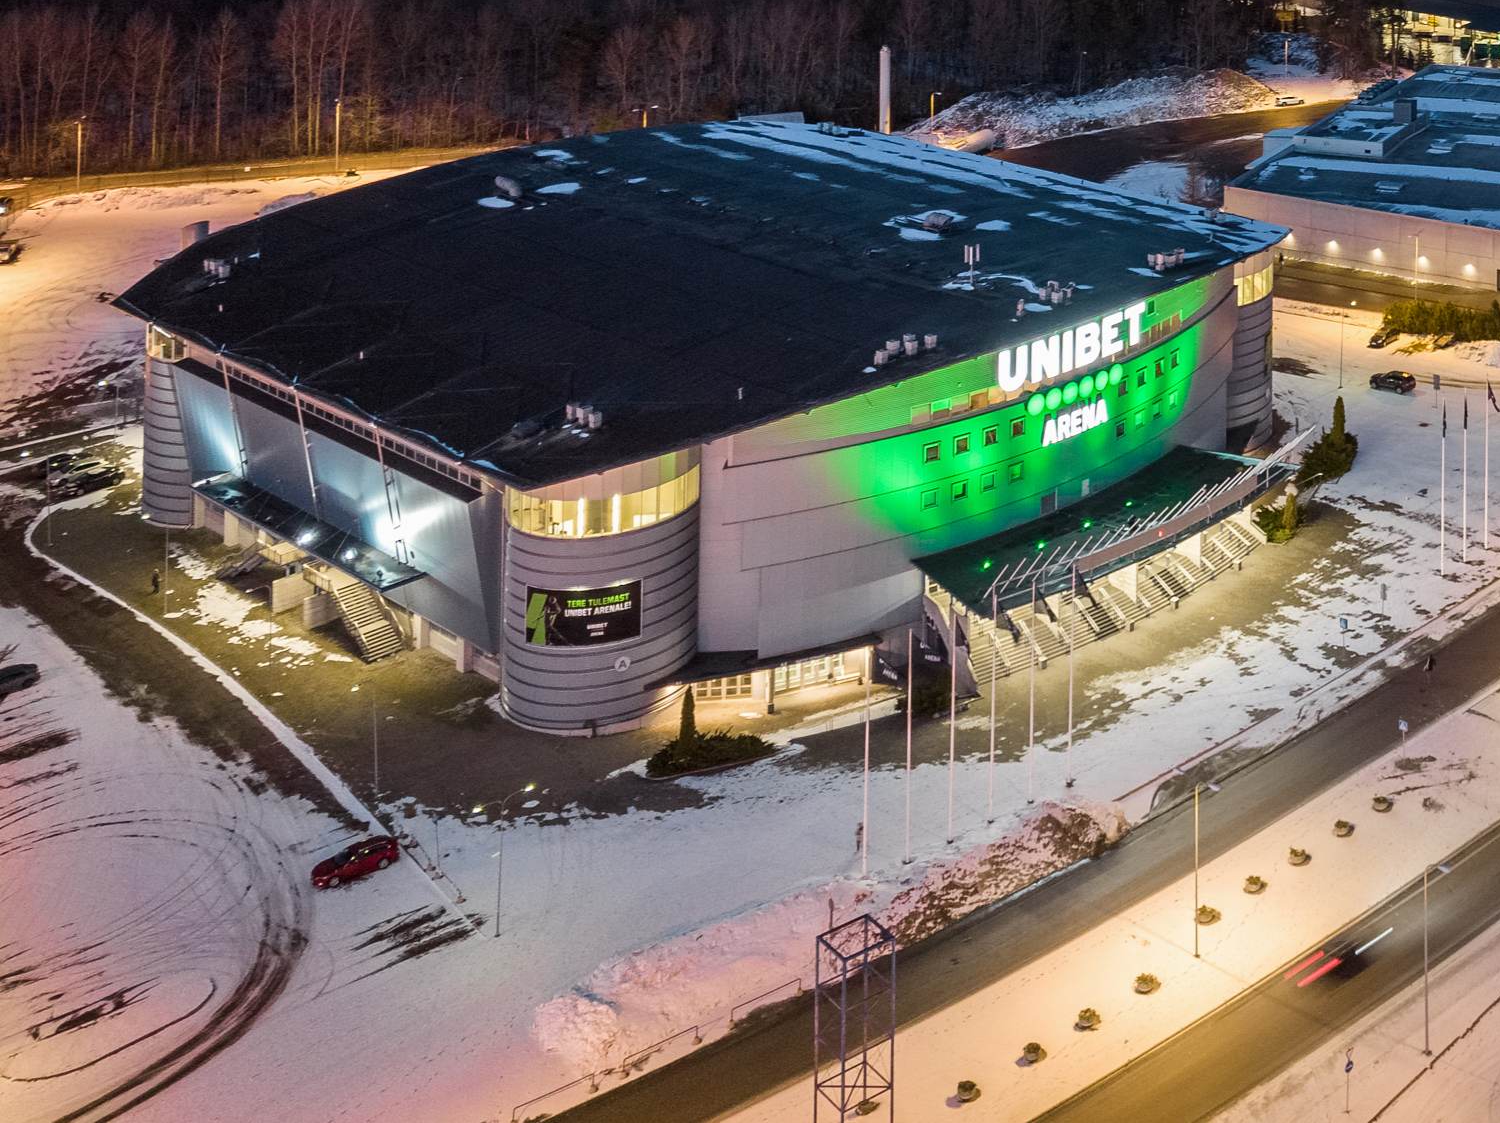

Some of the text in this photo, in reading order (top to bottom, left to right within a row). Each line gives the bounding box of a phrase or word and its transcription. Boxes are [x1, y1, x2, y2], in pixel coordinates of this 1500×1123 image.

[998, 302, 1145, 392] UNIBET
[1042, 399, 1108, 447] ARENA
[565, 601, 631, 617] UNIBET ARENALE!
[567, 593, 630, 608] TERE TULEMAST
